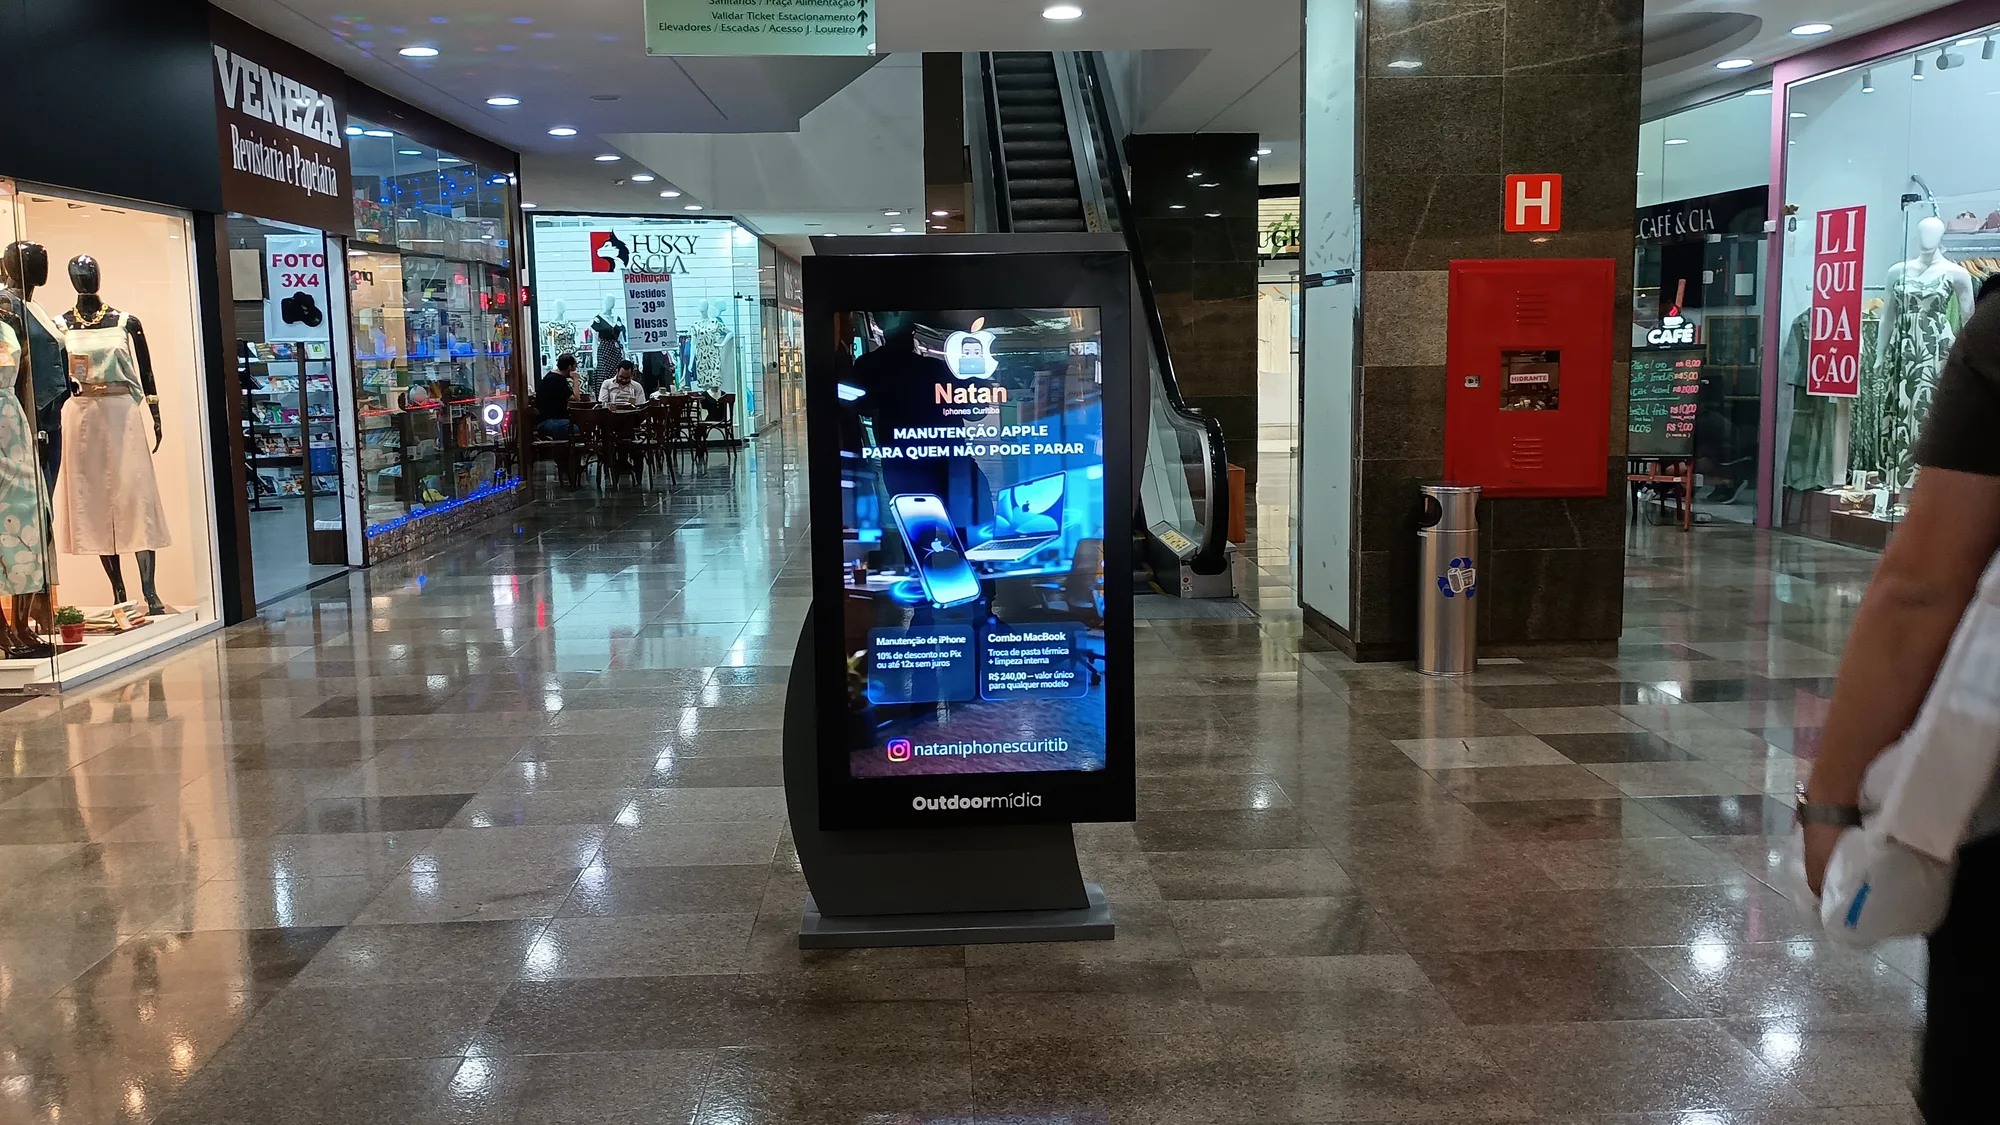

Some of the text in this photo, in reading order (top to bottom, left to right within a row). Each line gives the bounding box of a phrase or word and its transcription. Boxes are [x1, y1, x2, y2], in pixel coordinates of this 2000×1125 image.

[711, 11, 856, 21] Validar Ticket Estacionamento
[659, 22, 712, 32] Elevadores
[721, 23, 760, 33] Escadas
[769, 24, 803, 34] Acesso
[805, 25, 812, 36] J.
[815, 25, 856, 35] Loureiro
[214, 44, 341, 148] VENEZA
[230, 123, 338, 197] Revistaria e Papelaria
[1515, 181, 1551, 225] H
[1640, 208, 1715, 239] CAFÉ & CIA
[1819, 210, 1858, 255] LI
[630, 234, 700, 255] HUSKY
[272, 253, 325, 268] FOTO
[281, 273, 320, 288] 3X4
[1816, 260, 1856, 300] QUI
[629, 289, 666, 299] Vestidos
[634, 318, 668, 329] Blusas
[1814, 306, 1853, 341] DA
[1648, 323, 1693, 344] CAFÉ
[1811, 346, 1856, 389] ÇÃO
[1511, 374, 1548, 382] HIDRANTE
[935, 383, 1008, 404] Natan
[942, 407, 1000, 416] Iphones Curitiba
[894, 424, 1048, 440] MANUTENÇÃO APPLE
[862, 441, 1084, 459] PARA QUEM NÃO PODE PARAR
[876, 636, 966, 647] Manutenção de iPhone
[988, 632, 1066, 643] Combo MacBook
[877, 652, 892, 660] 10%
[893, 651, 903, 659] de
[904, 651, 938, 659] desconto
[950, 650, 962, 658] Pix
[988, 647, 1069, 657] Troca de pasta térmica
[887, 660, 900, 668] até
[901, 660, 914, 668] 12x
[931, 660, 950, 669] juros
[995, 657, 1023, 666] limpeza
[1025, 656, 1049, 664] interna
[988, 672, 999, 682] R$
[1000, 671, 1027, 681] 240,00
[1035, 671, 1052, 679] valor
[1054, 670, 1074, 679] único
[989, 680, 1069, 691] para qualquer modelo
[914, 738, 1069, 758] nataniphonescuritib
[912, 792, 1042, 811] Outdoormídia
